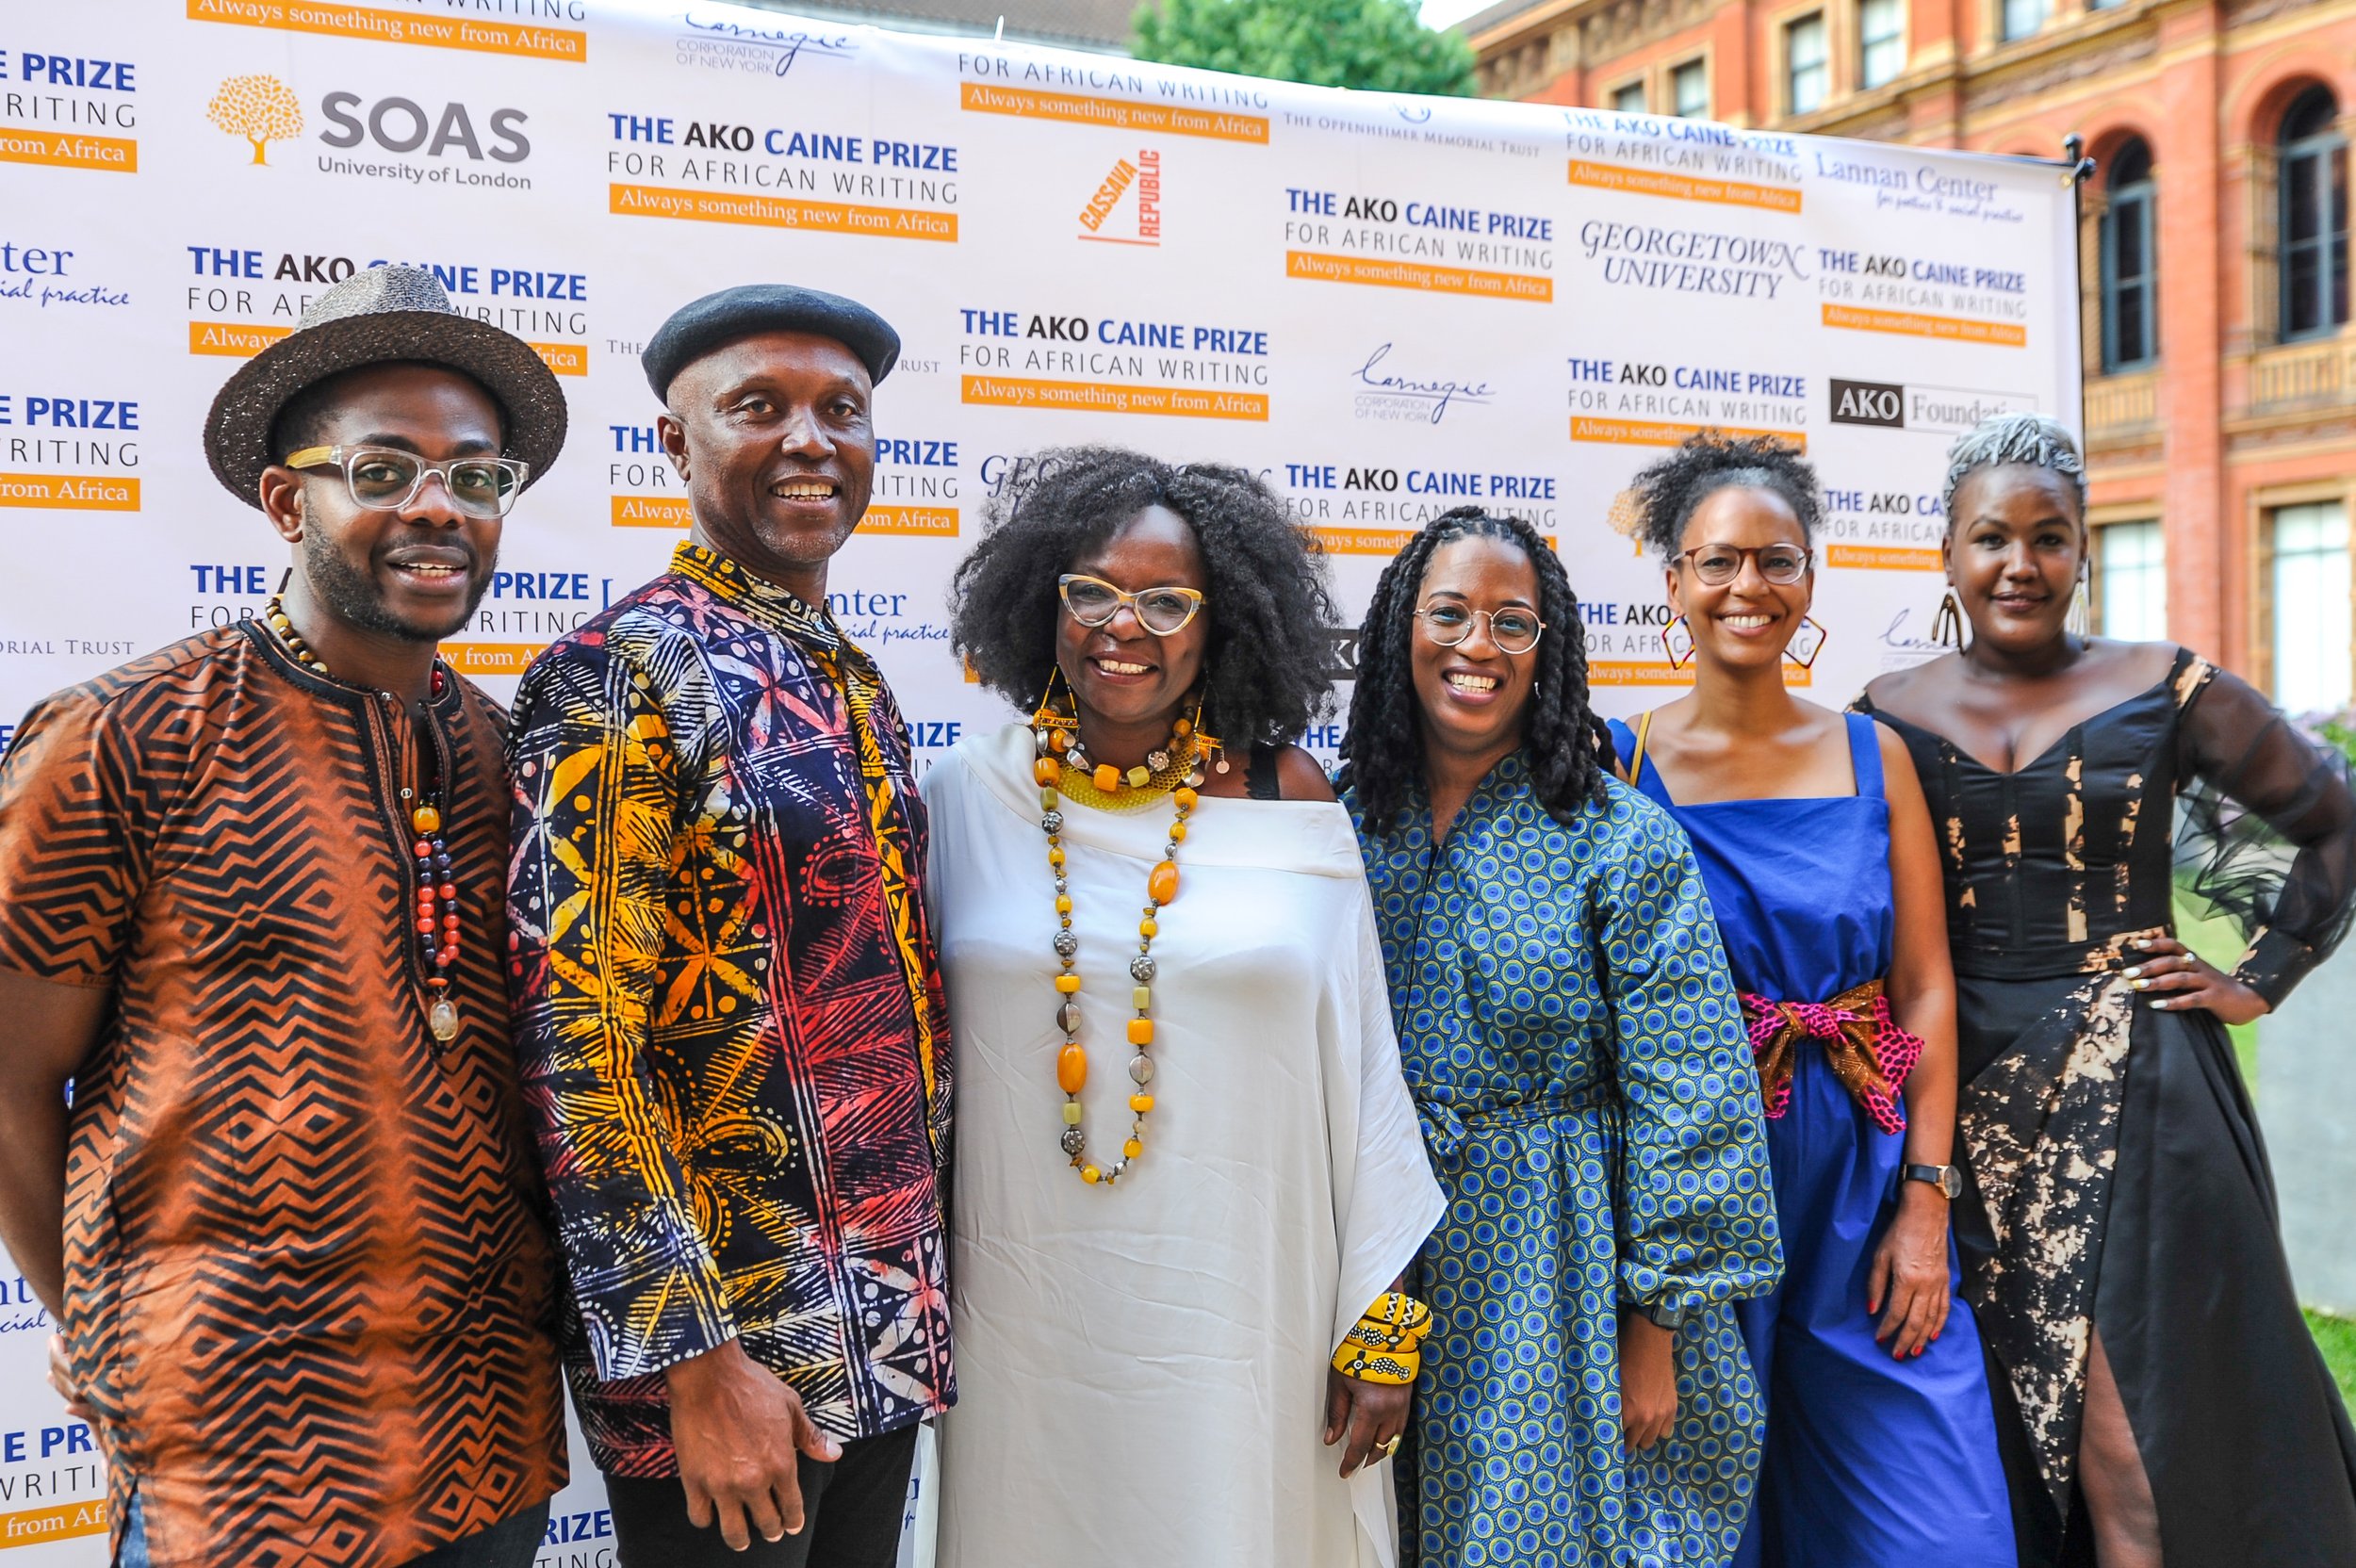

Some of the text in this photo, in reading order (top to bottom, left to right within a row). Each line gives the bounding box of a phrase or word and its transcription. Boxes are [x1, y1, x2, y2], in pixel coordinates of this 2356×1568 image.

[197, 0, 577, 54] Always something new from Africa
[676, 39, 775, 60] CORPORATION
[676, 53, 773, 74] OF NEW YORK
[23, 53, 136, 92] PRIZE
[958, 54, 1268, 109] FOR AFRICAN WRITING
[7, 92, 136, 128] RITING
[319, 91, 531, 163] SOAS
[969, 88, 1261, 139] Always something new from Africa
[608, 113, 957, 172] THE AKO CAINE PRIZE
[1284, 111, 1540, 158] THE OPPENHEIMER MEMORIAL TRUST
[1562, 111, 1608, 130] THE
[1614, 117, 1661, 138] AKO
[1667, 122, 1737, 148] CAINE
[0, 138, 125, 163] rom Africa
[1566, 133, 1803, 182] FOR AFRICAN WRITING
[318, 155, 532, 189] University of London
[609, 151, 957, 204] FOR AFRICAN WRITING
[1574, 164, 1796, 207] Always something new from Africa
[1815, 151, 1999, 203] Lannan Center
[1079, 158, 1138, 233] CASSAVA
[1138, 149, 1160, 237] REPUBLIC
[619, 188, 949, 234] Always something new from Africa
[1285, 188, 1553, 241] THE AKO CAINE PRIZE
[1285, 221, 1553, 270] FOR AFRICAN WRITING
[1580, 219, 1811, 281] GEORGETOWN
[187, 246, 263, 279] THE
[273, 253, 355, 284] AKO
[491, 268, 587, 302] PRIZE
[1293, 255, 1546, 296] Always something new from Africa
[1604, 255, 1783, 300] UNIVERSITY
[1818, 248, 2025, 294] THE AKO CAINE PRIZE
[41, 286, 129, 308] practice
[188, 286, 253, 314] FOR
[1819, 277, 2026, 318] FOR AFRICAN WRITING
[959, 309, 1268, 355] THE AKO CAINE PRIZE
[1826, 306, 1871, 326] Always
[606, 339, 643, 354] THE
[892, 359, 941, 374] RUST
[960, 345, 1268, 385] FOR AFRICAN WRITING
[1567, 358, 1806, 399] THE AKO CAINE PRIZE
[970, 379, 1261, 414] Always something new from Africa
[1351, 342, 1497, 424] Carnegie
[26, 397, 139, 431] PRIZE
[1354, 396, 1431, 411] CORPORATION
[1355, 408, 1430, 422] OF NEW YORK
[1568, 389, 1807, 426] FOR AFRICAN WRITING
[1837, 386, 1901, 420] AKO
[1577, 418, 1627, 441] Always
[10, 437, 139, 467] RITING
[875, 438, 958, 466] PRIZE
[0, 481, 128, 501] rom Africa
[610, 464, 666, 487] FOR
[871, 475, 958, 498] ITING
[1285, 464, 1336, 489] THE
[1343, 467, 1399, 491] AKO
[1406, 470, 1482, 496] CAINE
[1490, 475, 1556, 499] PRIZE
[621, 500, 693, 525] Always
[896, 511, 950, 529] Africa
[1286, 498, 1331, 518] FOR
[1825, 490, 1863, 512] THE
[1869, 492, 1910, 514] AKO
[1824, 519, 1860, 539] FOR
[1832, 549, 1939, 570] Always something
[190, 565, 266, 594] THE
[493, 571, 590, 600] PRIZE
[826, 589, 907, 617] nter
[1624, 604, 1672, 626] AKO
[64, 639, 135, 655] TRUST
[883, 623, 949, 645] practice
[466, 646, 515, 665] from
[6, 1516, 66, 1538] from
[539, 1509, 613, 1547] RIZE
